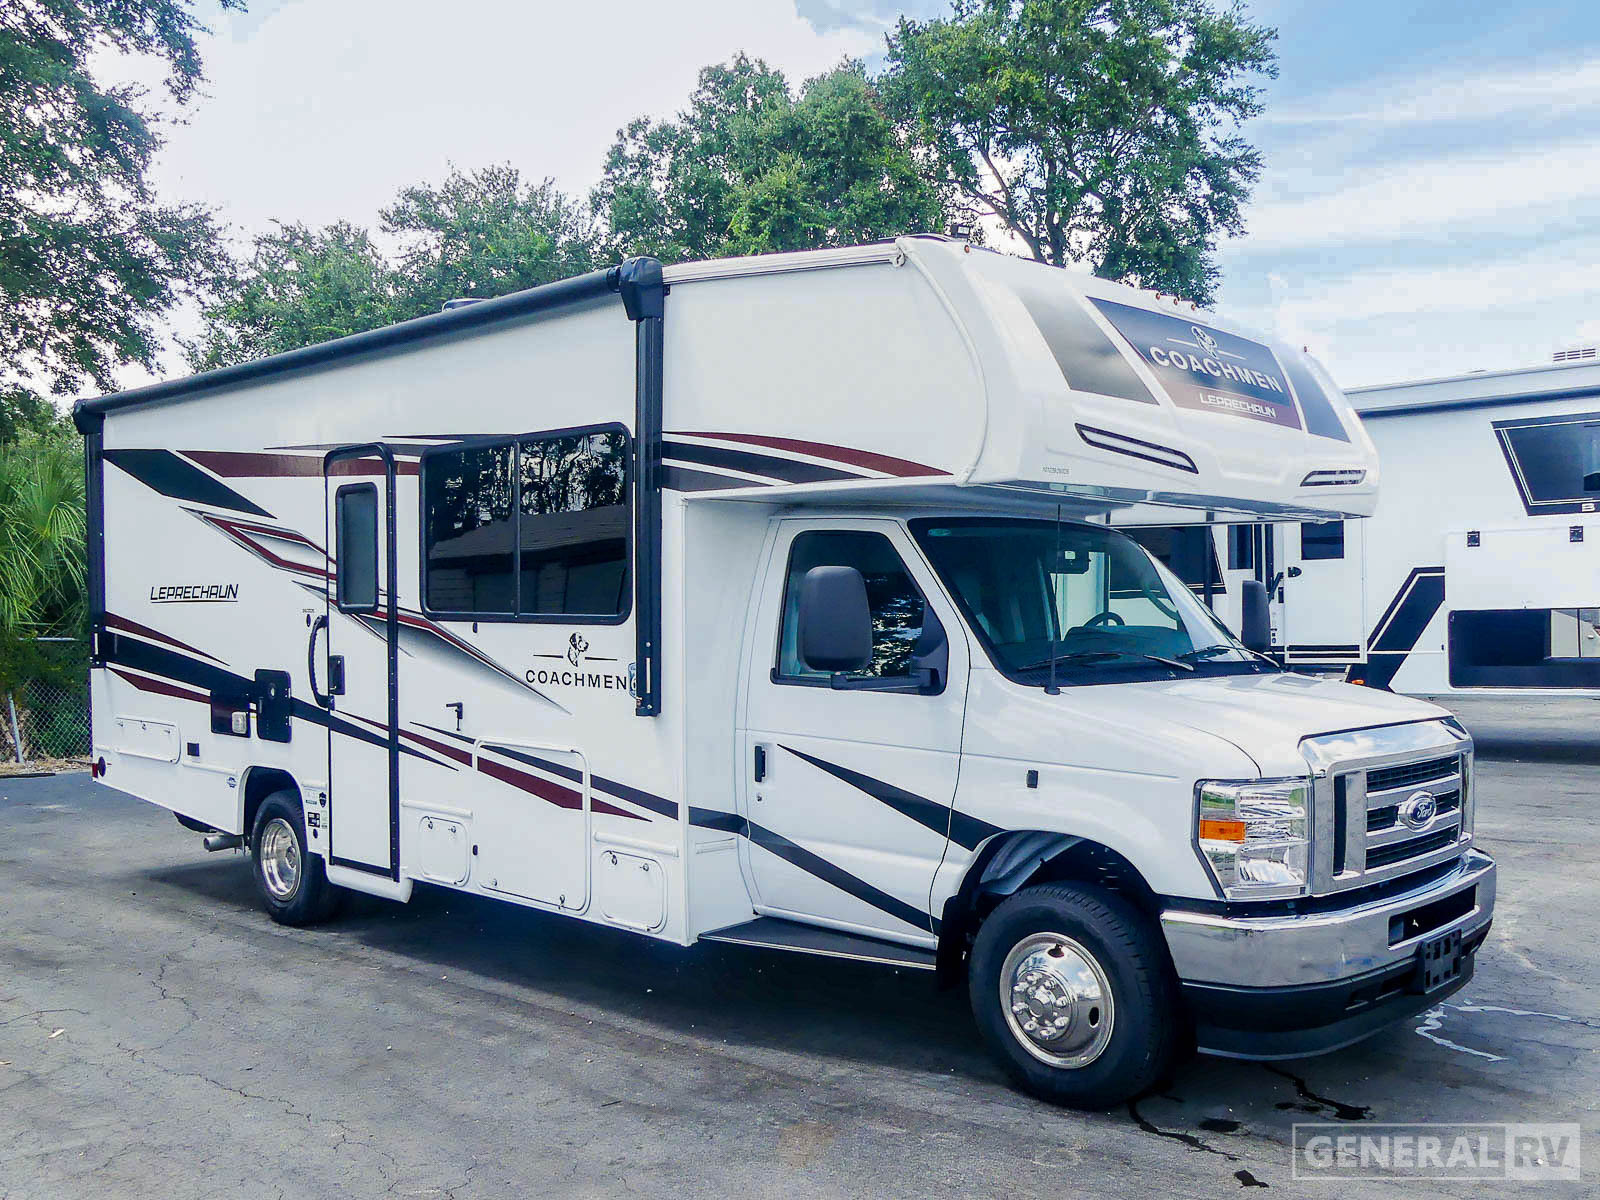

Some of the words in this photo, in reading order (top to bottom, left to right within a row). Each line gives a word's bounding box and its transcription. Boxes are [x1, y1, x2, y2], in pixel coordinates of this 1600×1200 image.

[1149, 346, 1283, 393] COACHMEN
[1200, 392, 1277, 418] LEPRECHAUN
[150, 584, 239, 600] LEPRECHAUN
[525, 669, 627, 690] COACHMEN
[1416, 802, 1433, 818] Ford
